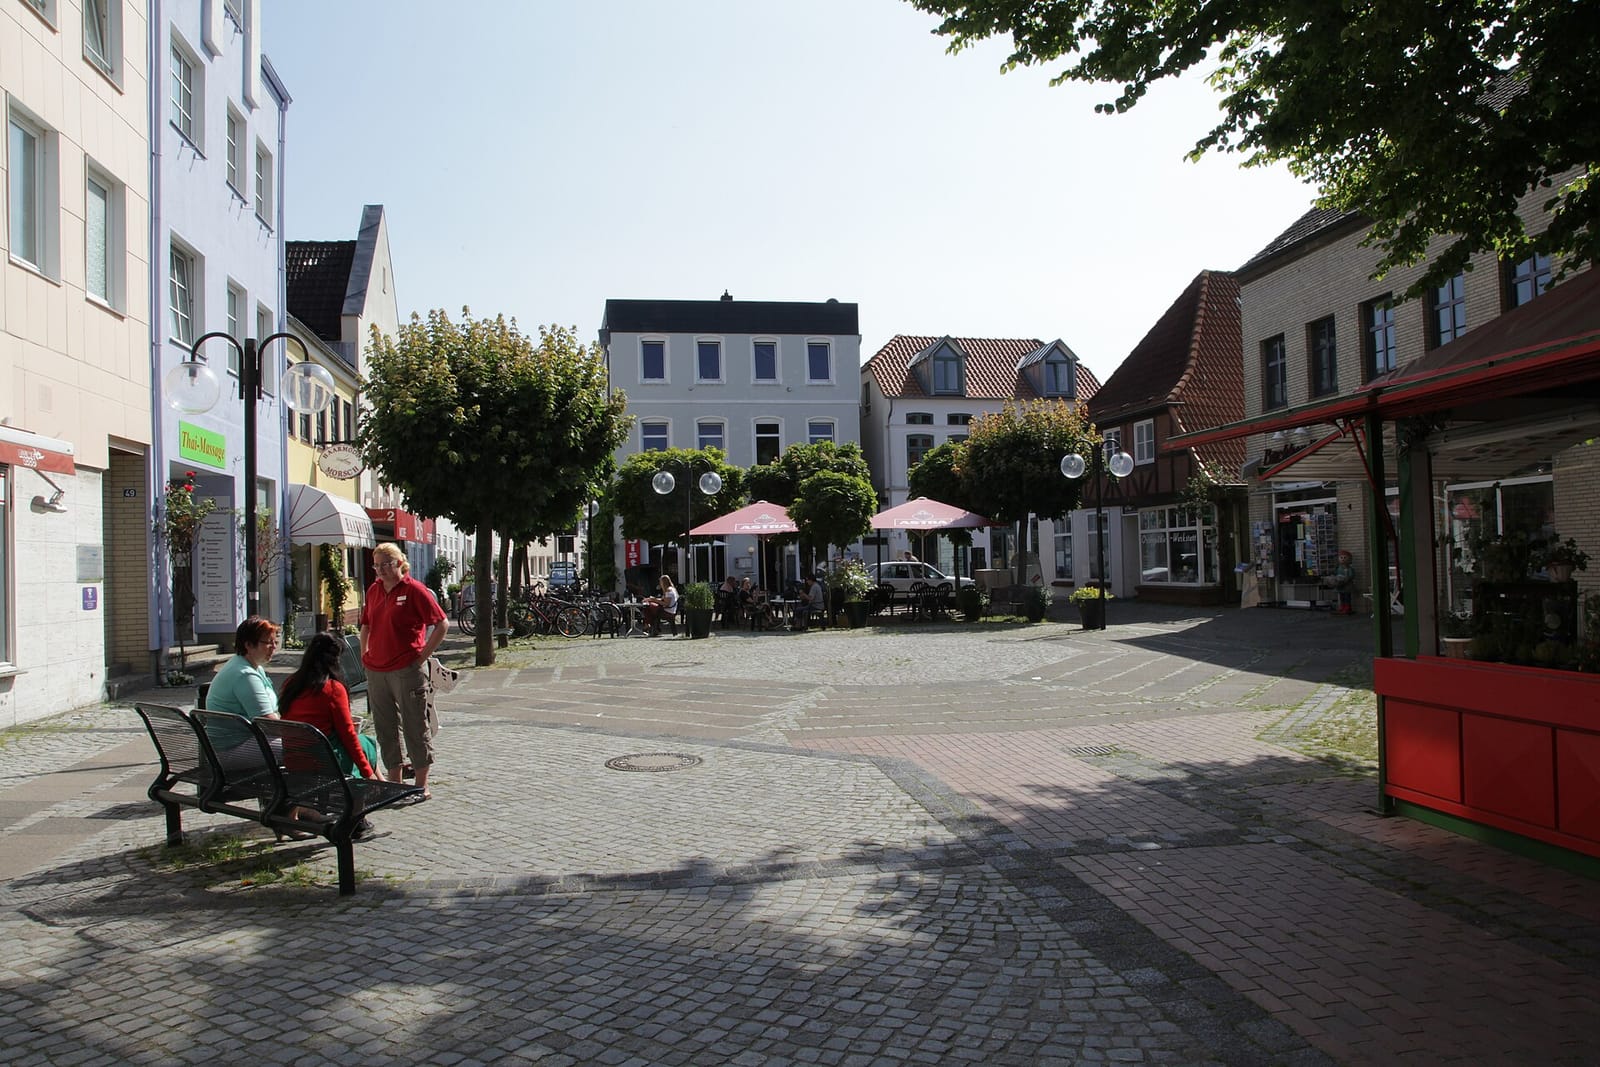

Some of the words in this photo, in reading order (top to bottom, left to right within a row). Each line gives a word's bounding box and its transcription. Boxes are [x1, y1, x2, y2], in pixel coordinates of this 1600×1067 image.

[182, 431, 225, 463] Thai-Massage
[325, 466, 360, 478] MORSCH
[125, 489, 136, 498] 49
[387, 511, 395, 522] 2
